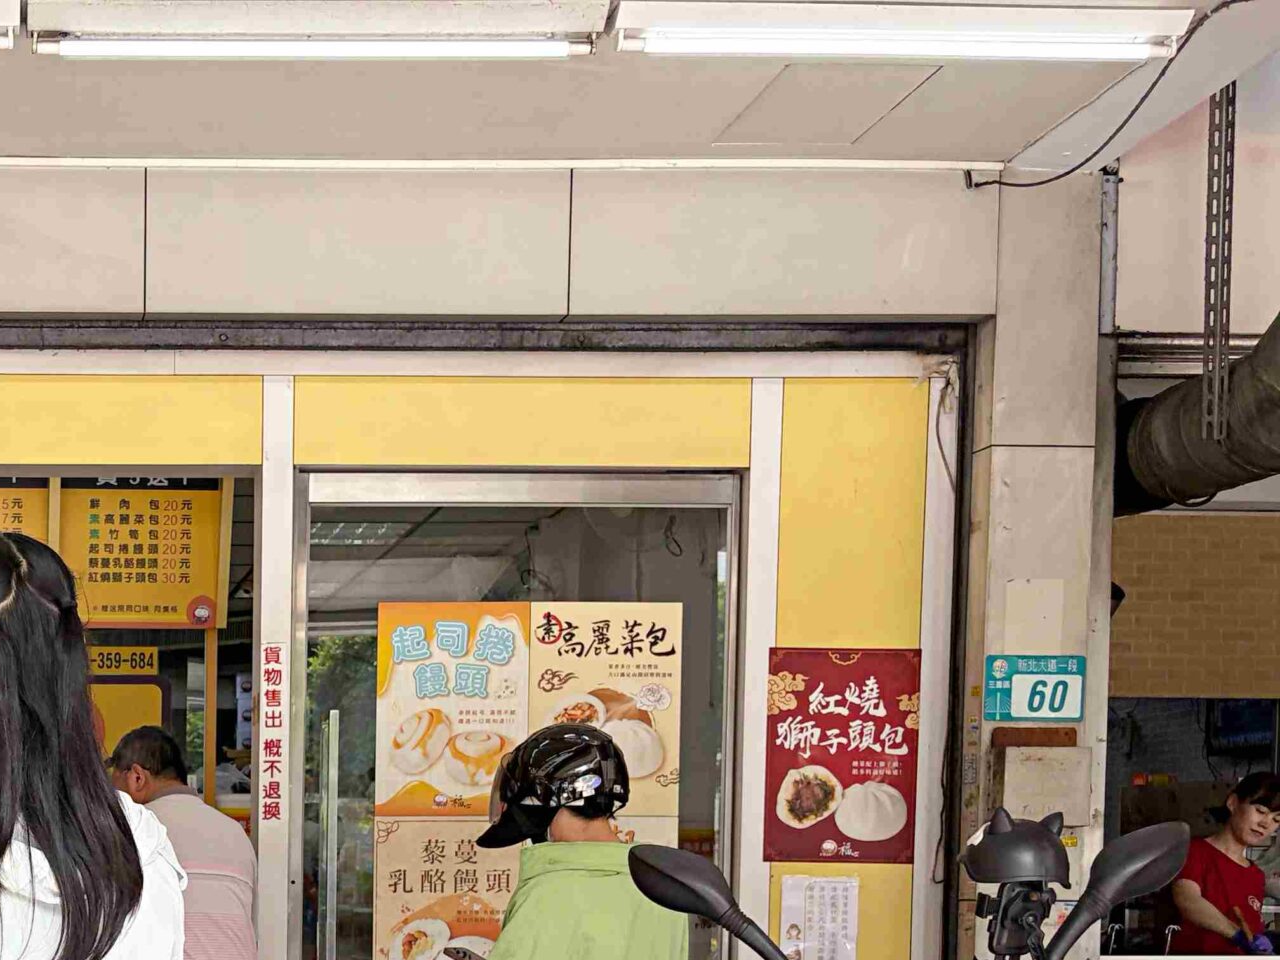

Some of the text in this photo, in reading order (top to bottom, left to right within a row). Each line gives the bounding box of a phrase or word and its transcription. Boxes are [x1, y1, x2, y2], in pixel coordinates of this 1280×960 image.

[392, 620, 516, 666] 起司捲
[262, 646, 283, 729] 貨物售出
[412, 663, 491, 700] 饅頭
[808, 675, 887, 718] 紅燒
[1027, 679, 1069, 713] 60
[775, 715, 909, 759] 獅子頭包
[387, 868, 512, 894] 乳酪饅頭
